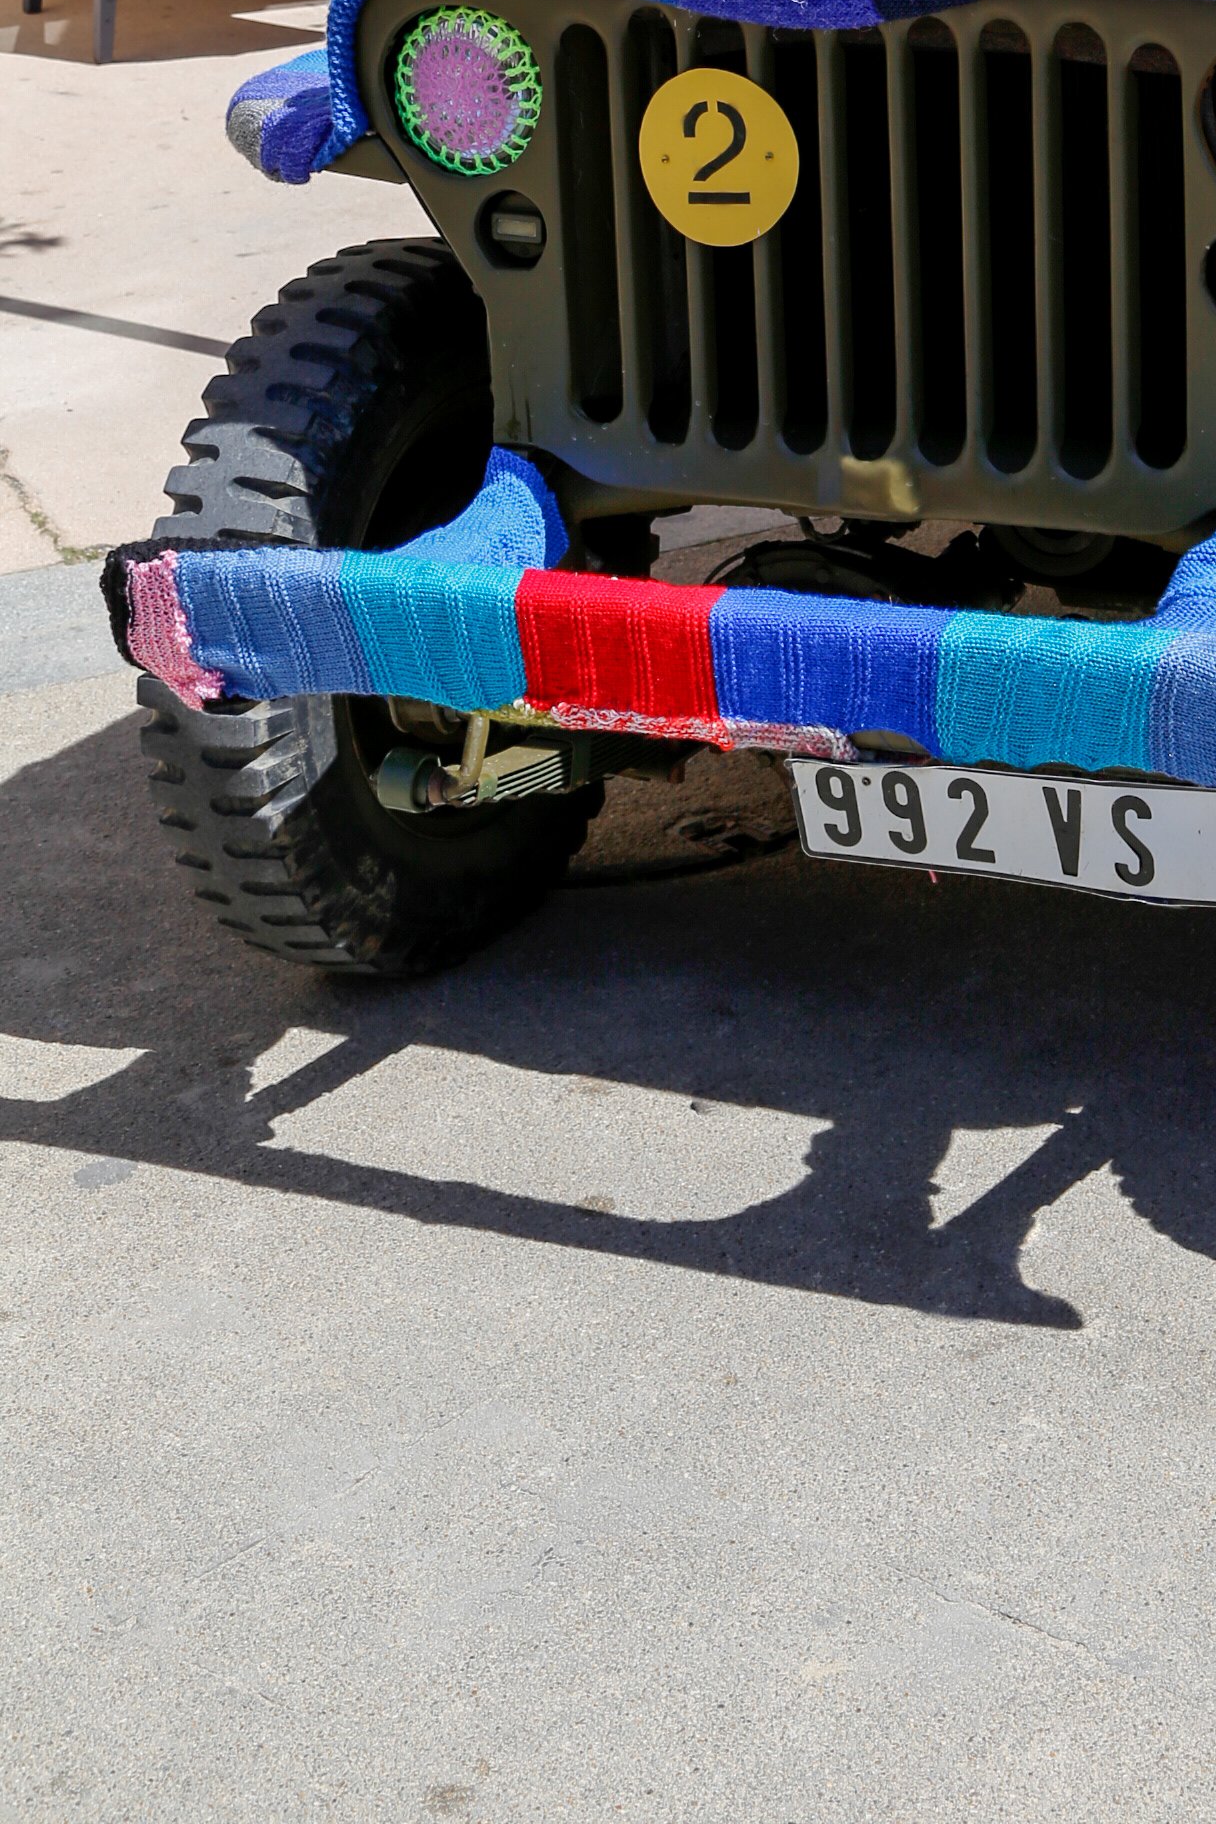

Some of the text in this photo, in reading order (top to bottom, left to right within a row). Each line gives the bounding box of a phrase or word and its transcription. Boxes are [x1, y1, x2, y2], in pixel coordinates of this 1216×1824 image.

[682, 99, 751, 205] 2
[814, 766, 997, 864] 992
[1042, 785, 1156, 887] VS
